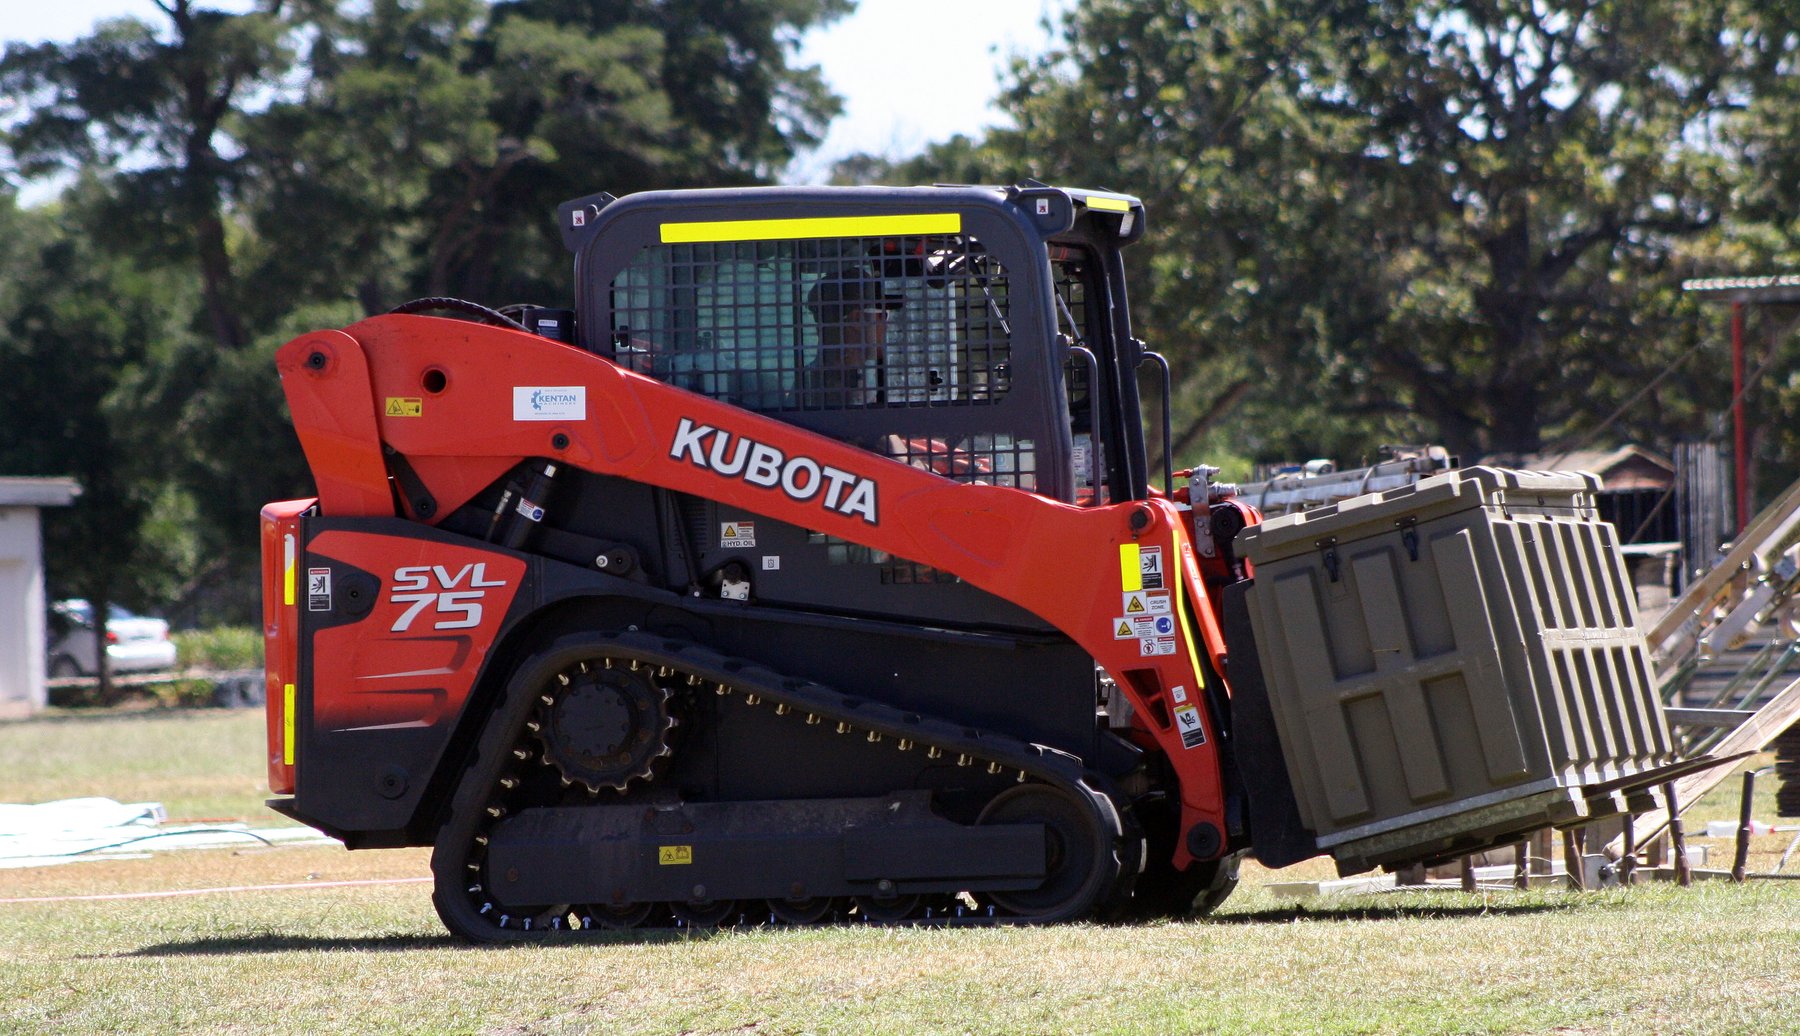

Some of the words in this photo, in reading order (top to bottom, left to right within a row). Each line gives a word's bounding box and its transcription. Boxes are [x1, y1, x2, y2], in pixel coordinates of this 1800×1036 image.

[538, 394, 577, 403] KENTAN
[669, 417, 877, 523] KUBOTA
[391, 562, 507, 592] SVL
[390, 590, 485, 632] 75
